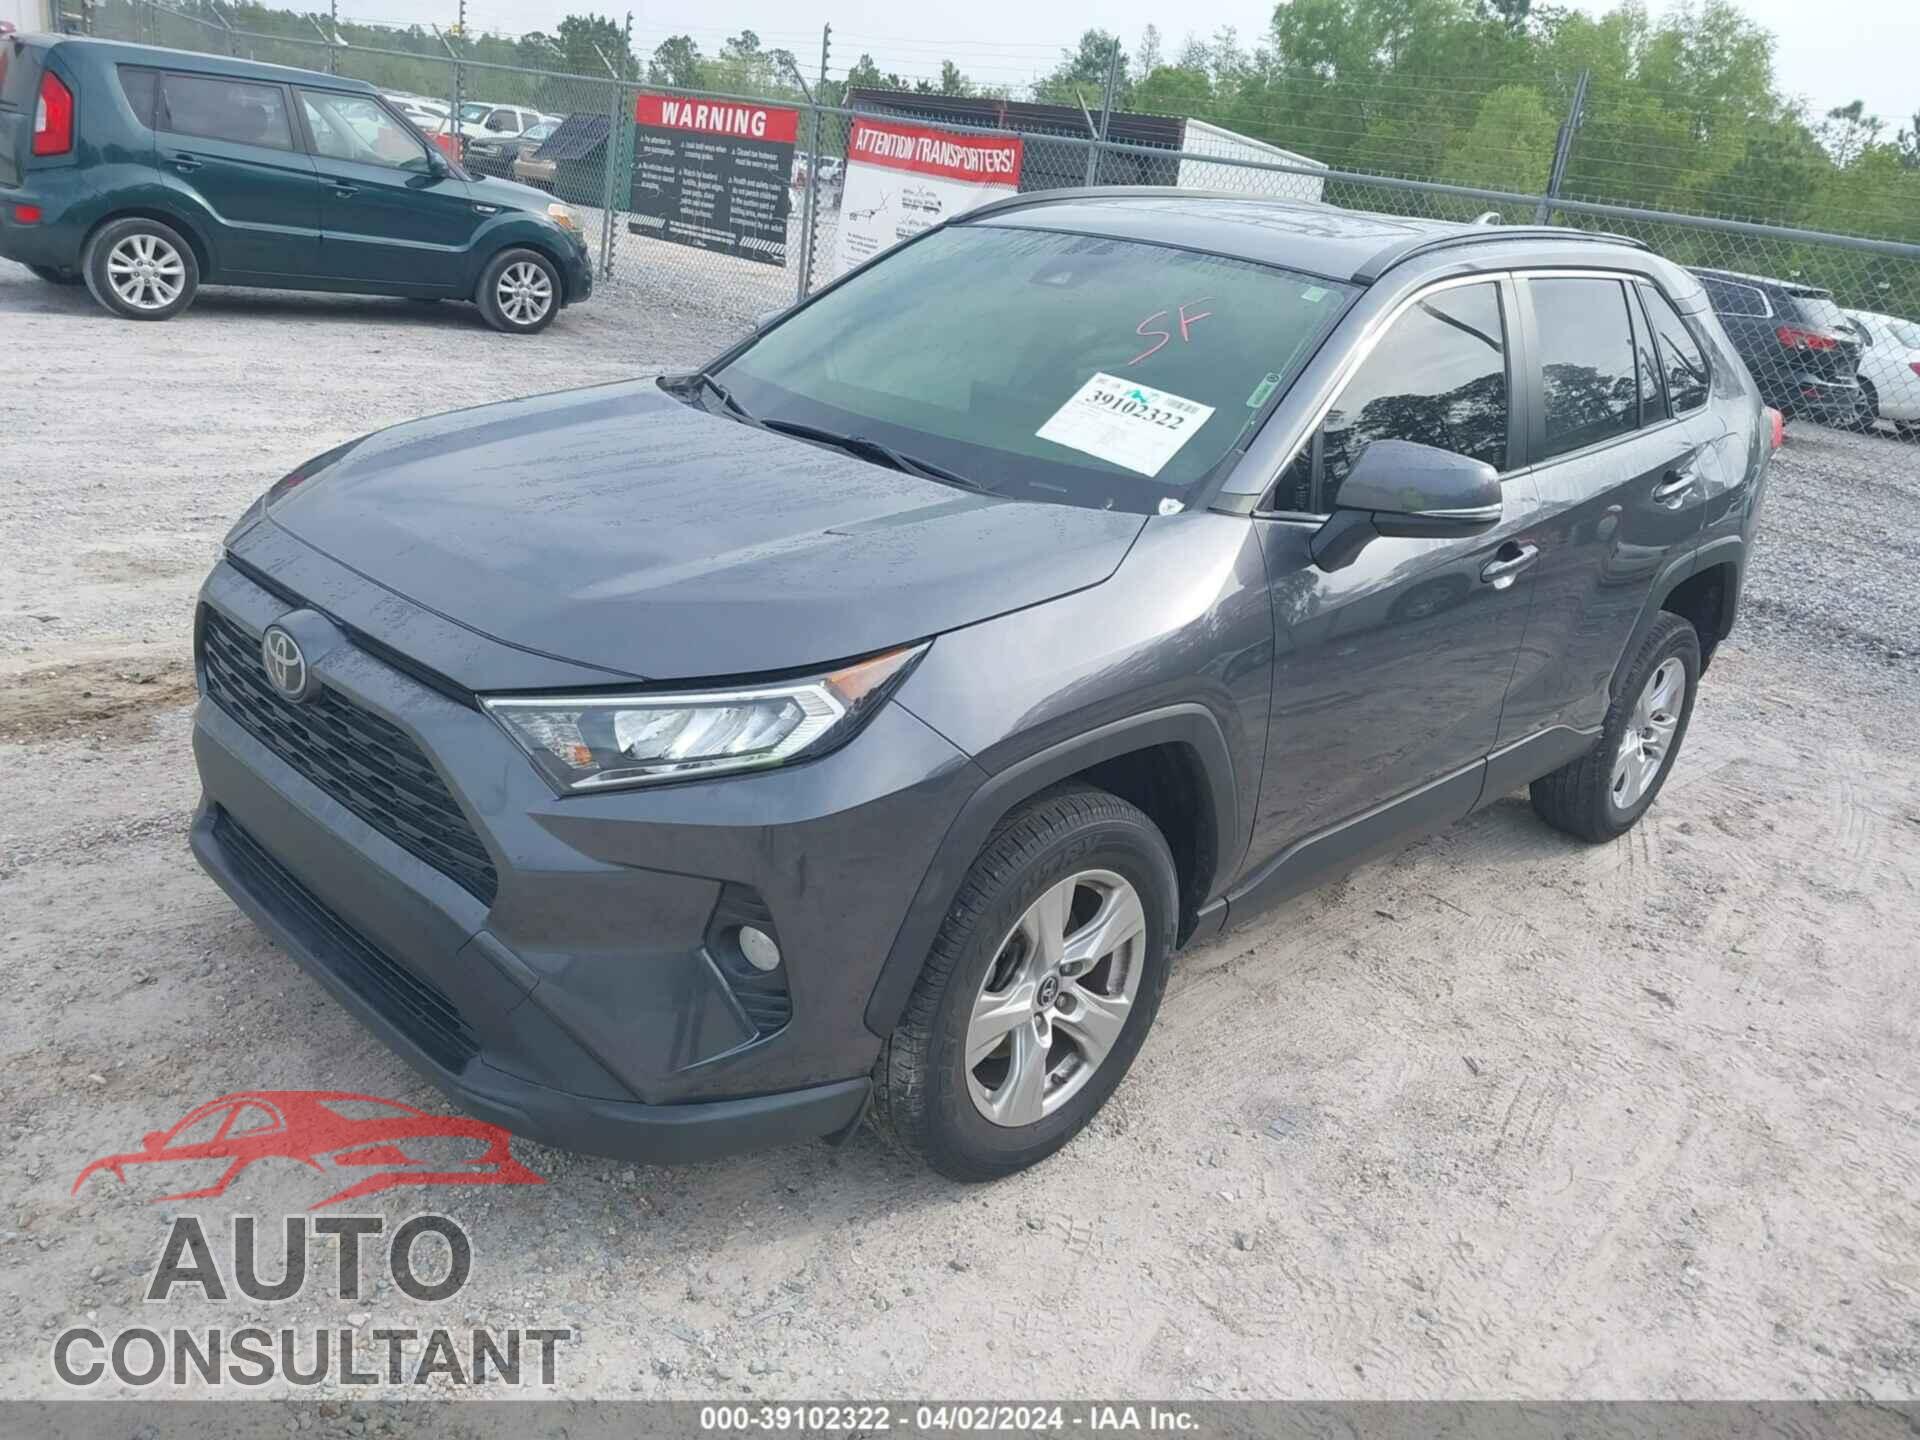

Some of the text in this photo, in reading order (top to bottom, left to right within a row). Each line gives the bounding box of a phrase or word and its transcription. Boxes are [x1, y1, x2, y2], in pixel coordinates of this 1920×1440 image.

[661, 101, 767, 136] WARNING
[855, 127, 1015, 173] ATTENTION TRANSPORTERS!
[1084, 389, 1185, 431] 39102322
